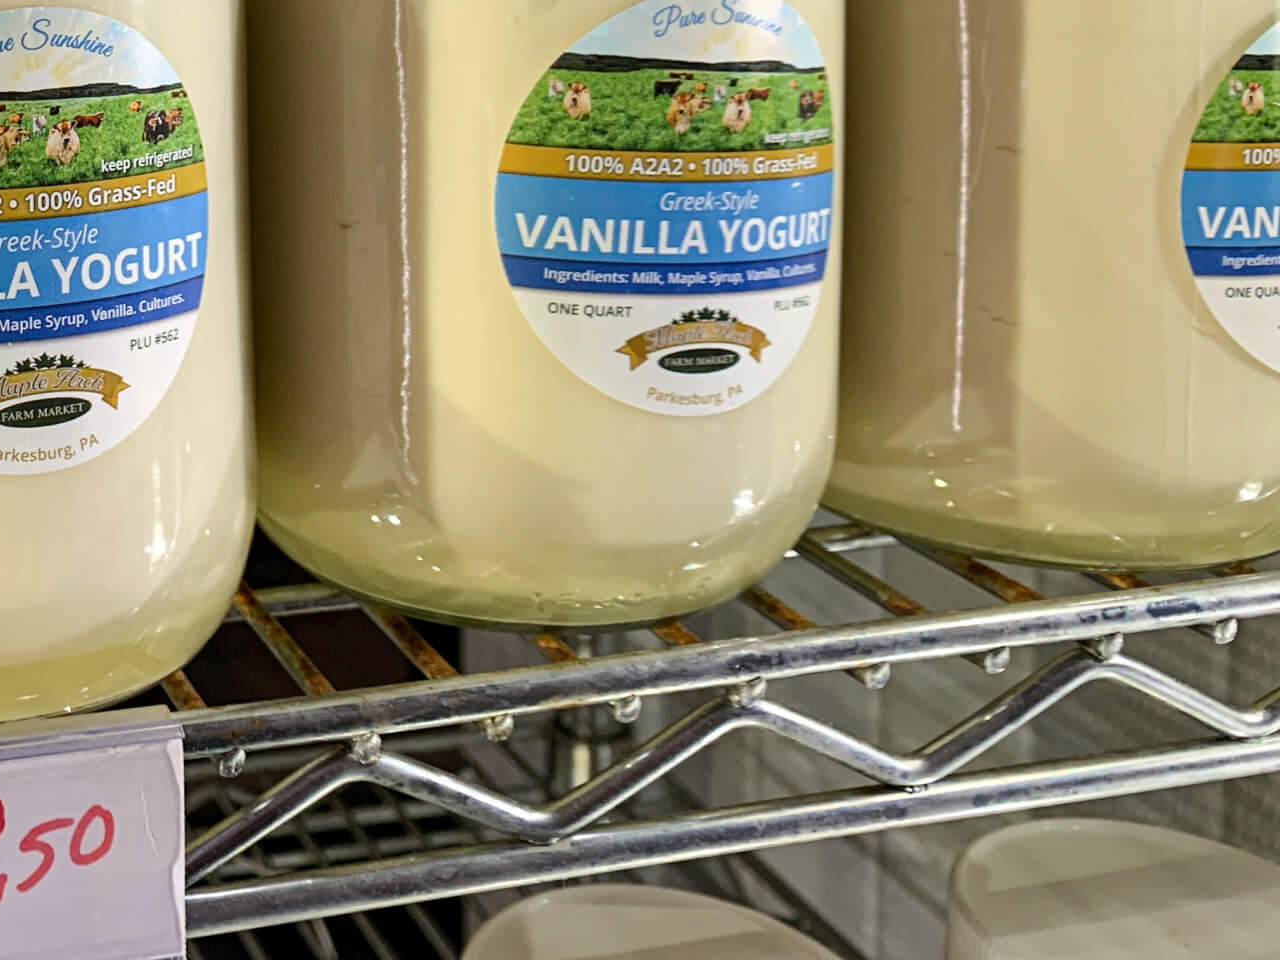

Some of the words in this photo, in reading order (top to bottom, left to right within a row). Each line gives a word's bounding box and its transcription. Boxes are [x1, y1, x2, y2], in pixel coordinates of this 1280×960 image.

[652, 4, 706, 38] Pure
[20, 18, 114, 58] Sunshine
[100, 157, 132, 174] keep
[133, 145, 194, 170] refrigerated
[565, 154, 624, 174] 100%
[629, 156, 684, 176] A2A2
[702, 156, 749, 175] 100%
[25, 191, 83, 213] 100%
[88, 175, 177, 207] Grass-Fed
[659, 190, 759, 214] Greek-Style
[515, 212, 708, 255] VANILLA
[718, 208, 830, 253] YOGURT
[52, 232, 203, 295] YOGURT
[543, 267, 629, 284] Ingredients:
[632, 272, 664, 285] Milk,
[668, 272, 706, 287] Maple
[1225, 287, 1251, 298] ONE
[45, 311, 88, 331] Syrup,
[91, 303, 137, 323] Vanilla.
[139, 293, 185, 314] Cultures.
[548, 302, 580, 316] ONE
[583, 304, 633, 318] QUART
[130, 337, 151, 352] PLU
[154, 329, 180, 347] #562
[1, 408, 34, 422] FARM
[37, 402, 85, 419] MARKET
[79, 433, 100, 451] PA
